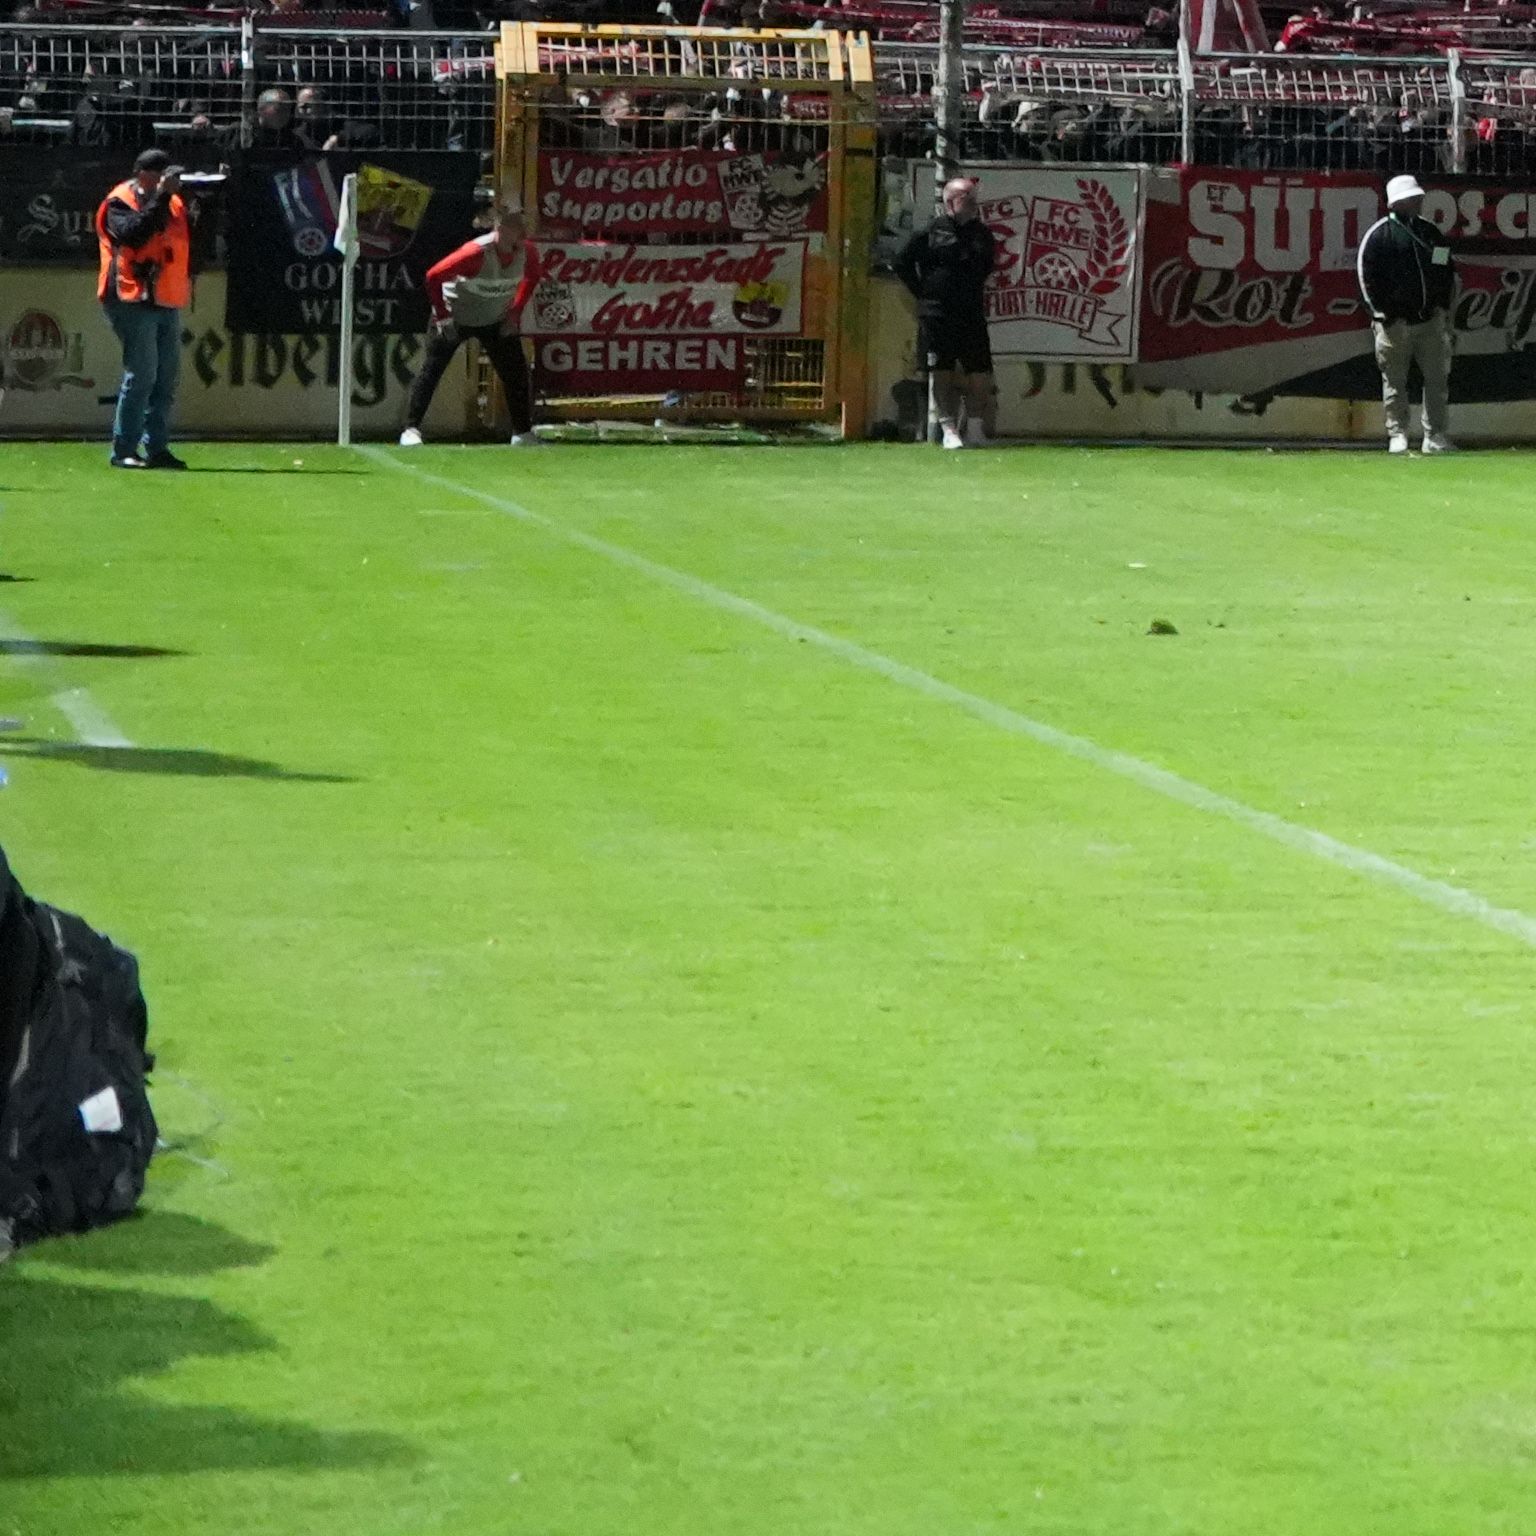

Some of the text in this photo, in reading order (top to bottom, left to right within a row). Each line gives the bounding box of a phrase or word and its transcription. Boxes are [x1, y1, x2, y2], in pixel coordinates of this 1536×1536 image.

[549, 156, 709, 194] Versatio
[543, 191, 723, 225] Supporters
[982, 201, 1014, 219] FC
[1048, 204, 1081, 224] FC
[1421, 189, 1485, 236] OS
[1033, 221, 1091, 245] RWE
[539, 243, 786, 288] Residenzstadt
[541, 339, 737, 372] GEHREN
